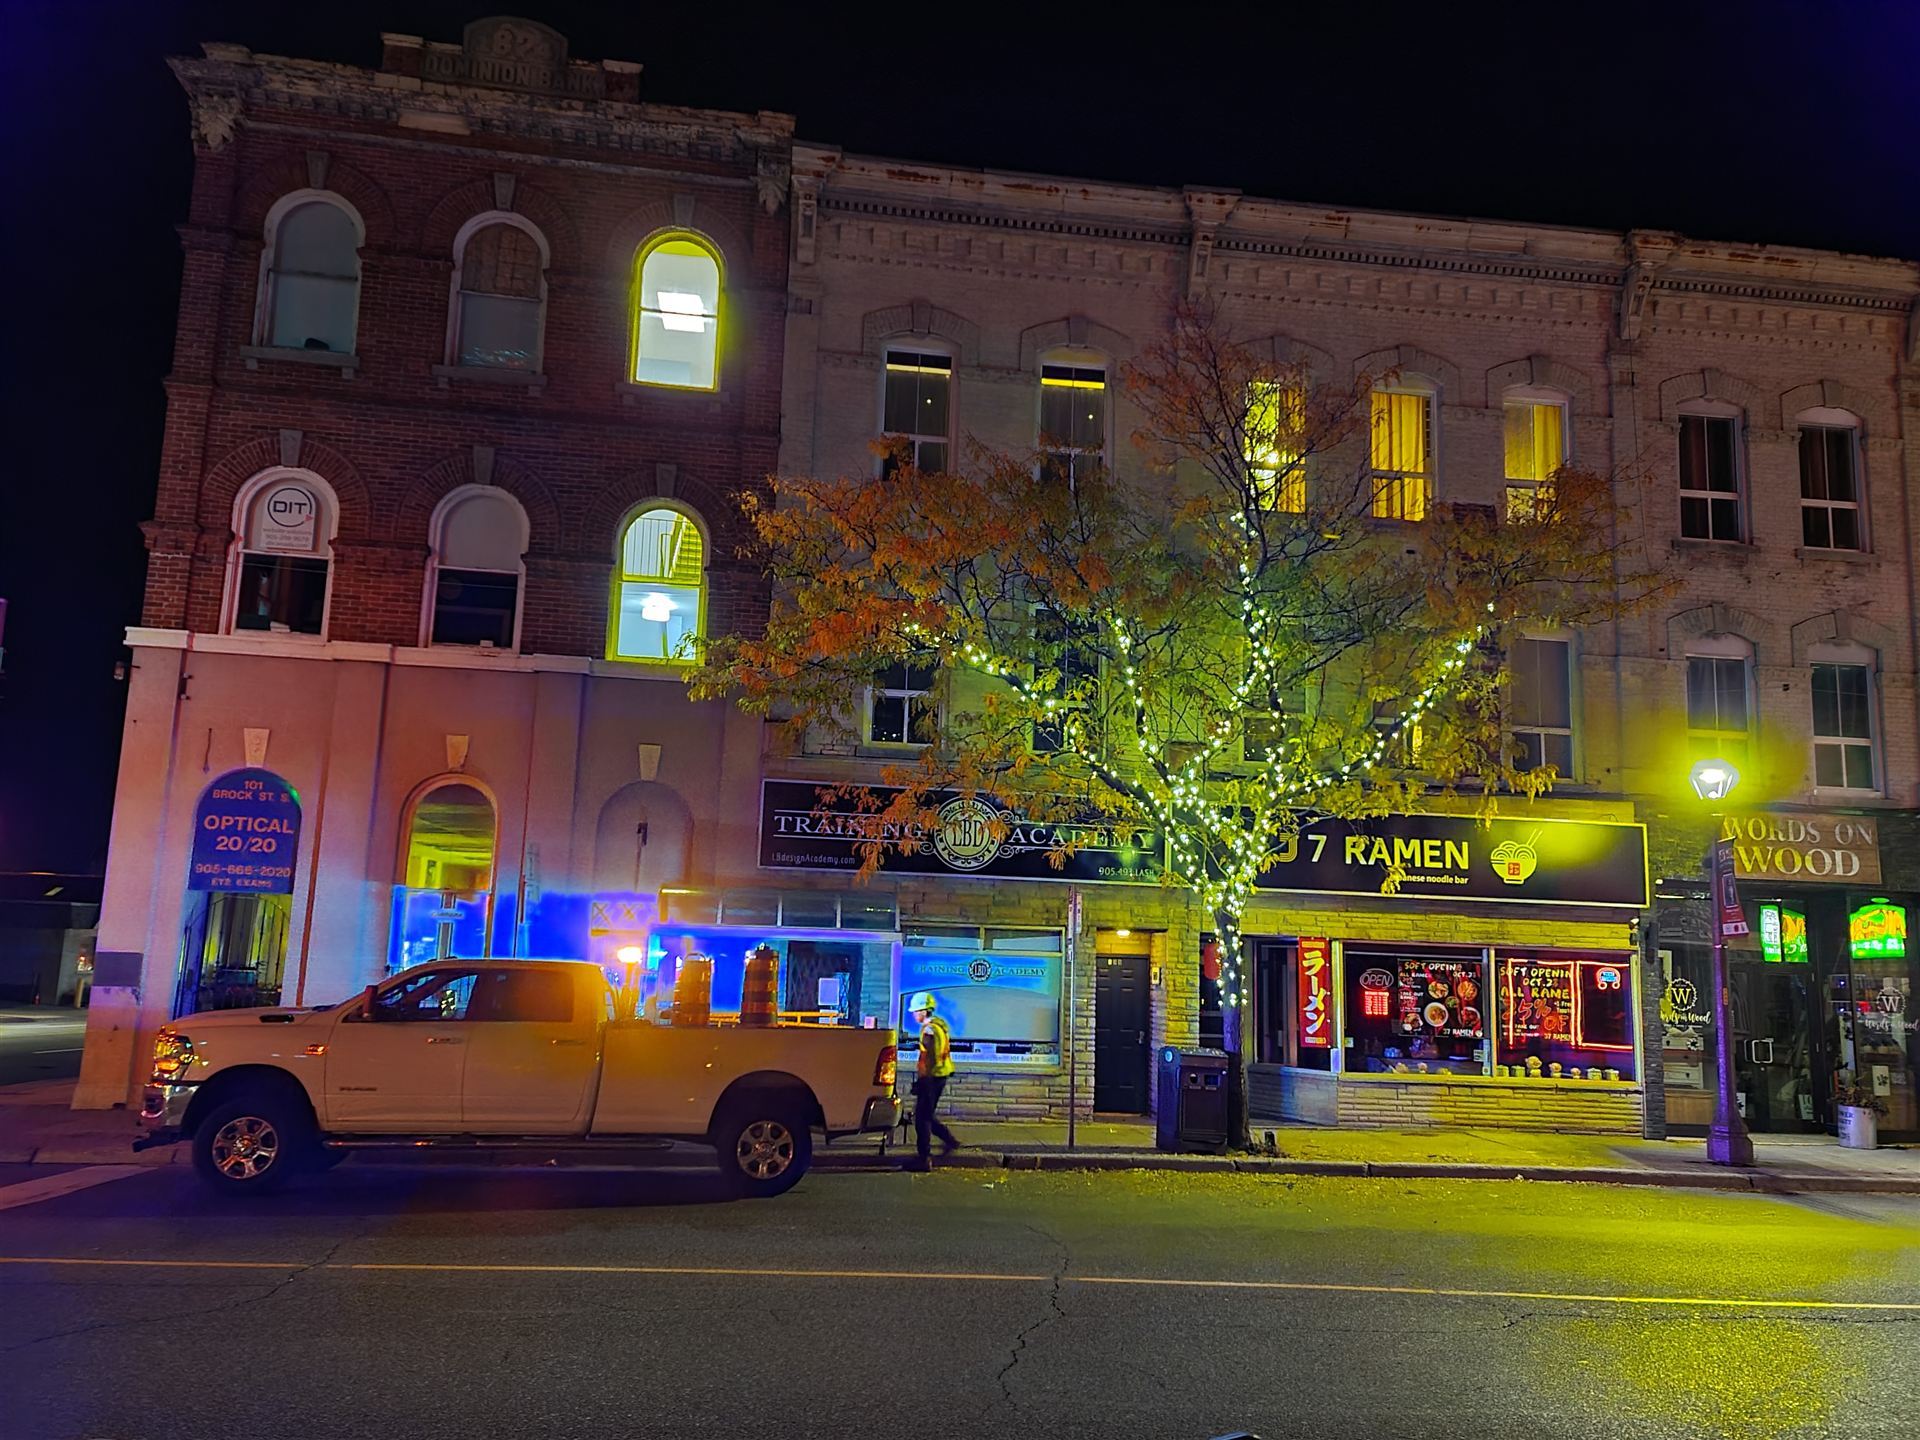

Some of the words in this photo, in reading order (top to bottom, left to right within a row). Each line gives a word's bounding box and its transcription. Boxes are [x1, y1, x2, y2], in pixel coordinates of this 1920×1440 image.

[424, 54, 528, 86] DOMINION
[272, 500, 308, 515] DIT
[212, 789, 254, 801] BROCK
[203, 814, 295, 834] OPTICAL
[774, 815, 924, 838] TRAINNG
[1722, 816, 1821, 844] WORDS
[1834, 822, 1873, 846] ON
[215, 835, 278, 853] 20/20
[1345, 836, 1469, 870] RAMEN
[1734, 844, 1861, 877] WOOD
[1426, 876, 1453, 885] noodle
[1454, 877, 1469, 886] bar
[914, 966, 965, 974] TRAINING
[994, 967, 1047, 976] ACADEMY
[1404, 961, 1426, 970] SOFT
[1500, 966, 1527, 977] SOFT
[1530, 968, 1573, 978] OPENIN
[1362, 975, 1391, 986] OPEN
[1302, 950, 1326, 1035] ラーメン
[1531, 986, 1570, 1000] RAME
[1671, 988, 1691, 1005] W
[1881, 996, 1900, 1011] W
[1452, 1028, 1474, 1036] RAMEN
